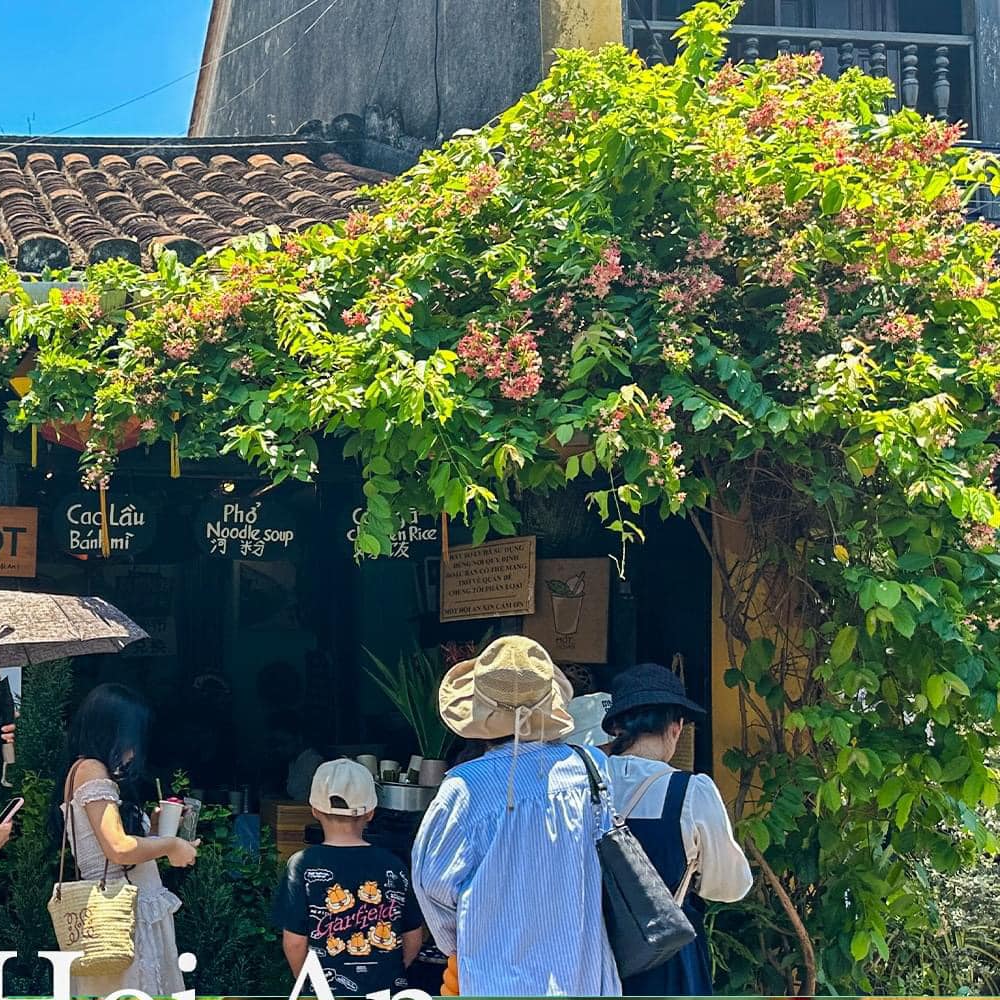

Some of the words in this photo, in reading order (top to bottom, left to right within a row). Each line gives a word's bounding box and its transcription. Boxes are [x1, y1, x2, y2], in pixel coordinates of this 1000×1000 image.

[109, 503, 145, 526] Lầu
[223, 501, 261, 524] Phở
[206, 520, 261, 540] Noodle
[262, 528, 294, 548] soup
[408, 525, 437, 542] Rice
